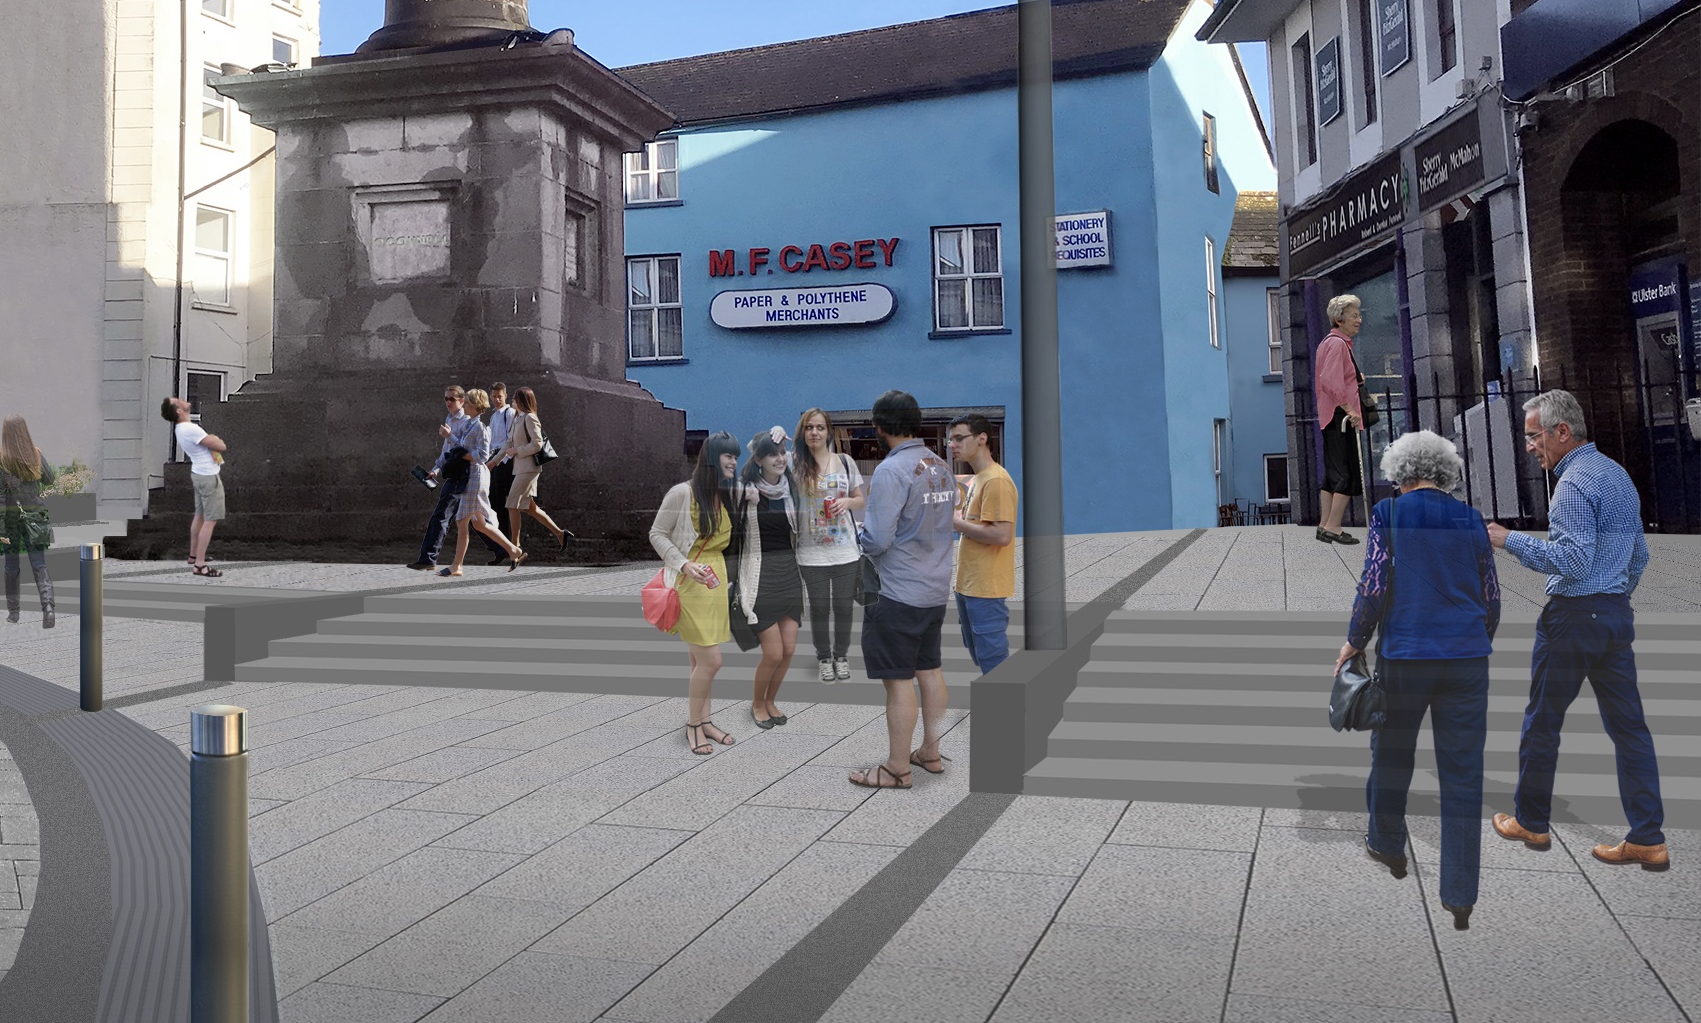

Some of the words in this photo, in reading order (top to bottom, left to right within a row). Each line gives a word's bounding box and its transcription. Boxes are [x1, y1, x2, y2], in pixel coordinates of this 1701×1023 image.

[1449, 142, 1480, 171] McMahon
[1322, 173, 1398, 242] PHARMACY
[1062, 232, 1104, 246] SCHOOL
[779, 237, 899, 273] CASEY
[734, 295, 773, 309] PAPER
[780, 294, 790, 306] &
[797, 289, 867, 306] POLYTHENE
[1638, 287, 1658, 303] Ulster
[1658, 281, 1677, 298] Bank
[766, 307, 839, 322] MERCHANTS
